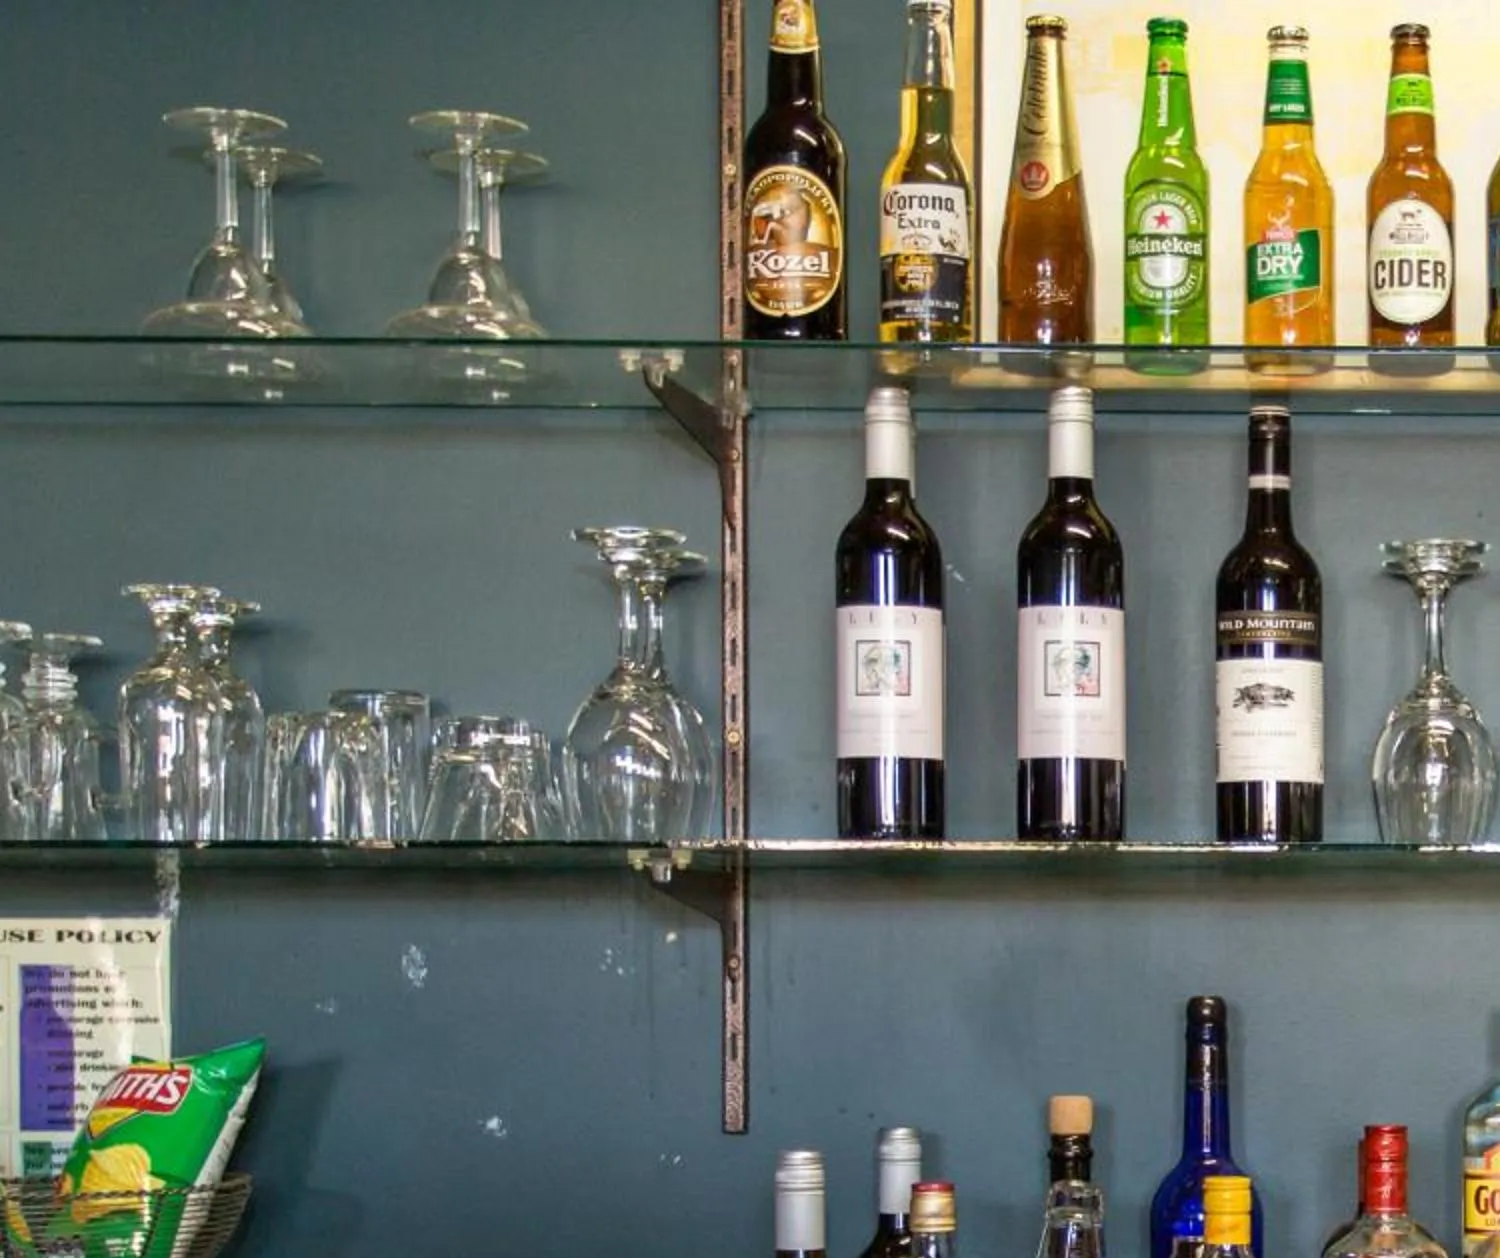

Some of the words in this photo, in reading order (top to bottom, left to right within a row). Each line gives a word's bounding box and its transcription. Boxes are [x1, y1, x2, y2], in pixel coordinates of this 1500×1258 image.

[883, 191, 959, 218] Corona
[897, 214, 940, 230] Extra
[1127, 236, 1203, 257] Heineken
[1256, 243, 1303, 256] EXTRA
[747, 250, 831, 279] Kozel
[1256, 256, 1303, 275] DRY
[1374, 259, 1447, 291] CIDER
[56, 929, 161, 943] POLICY
